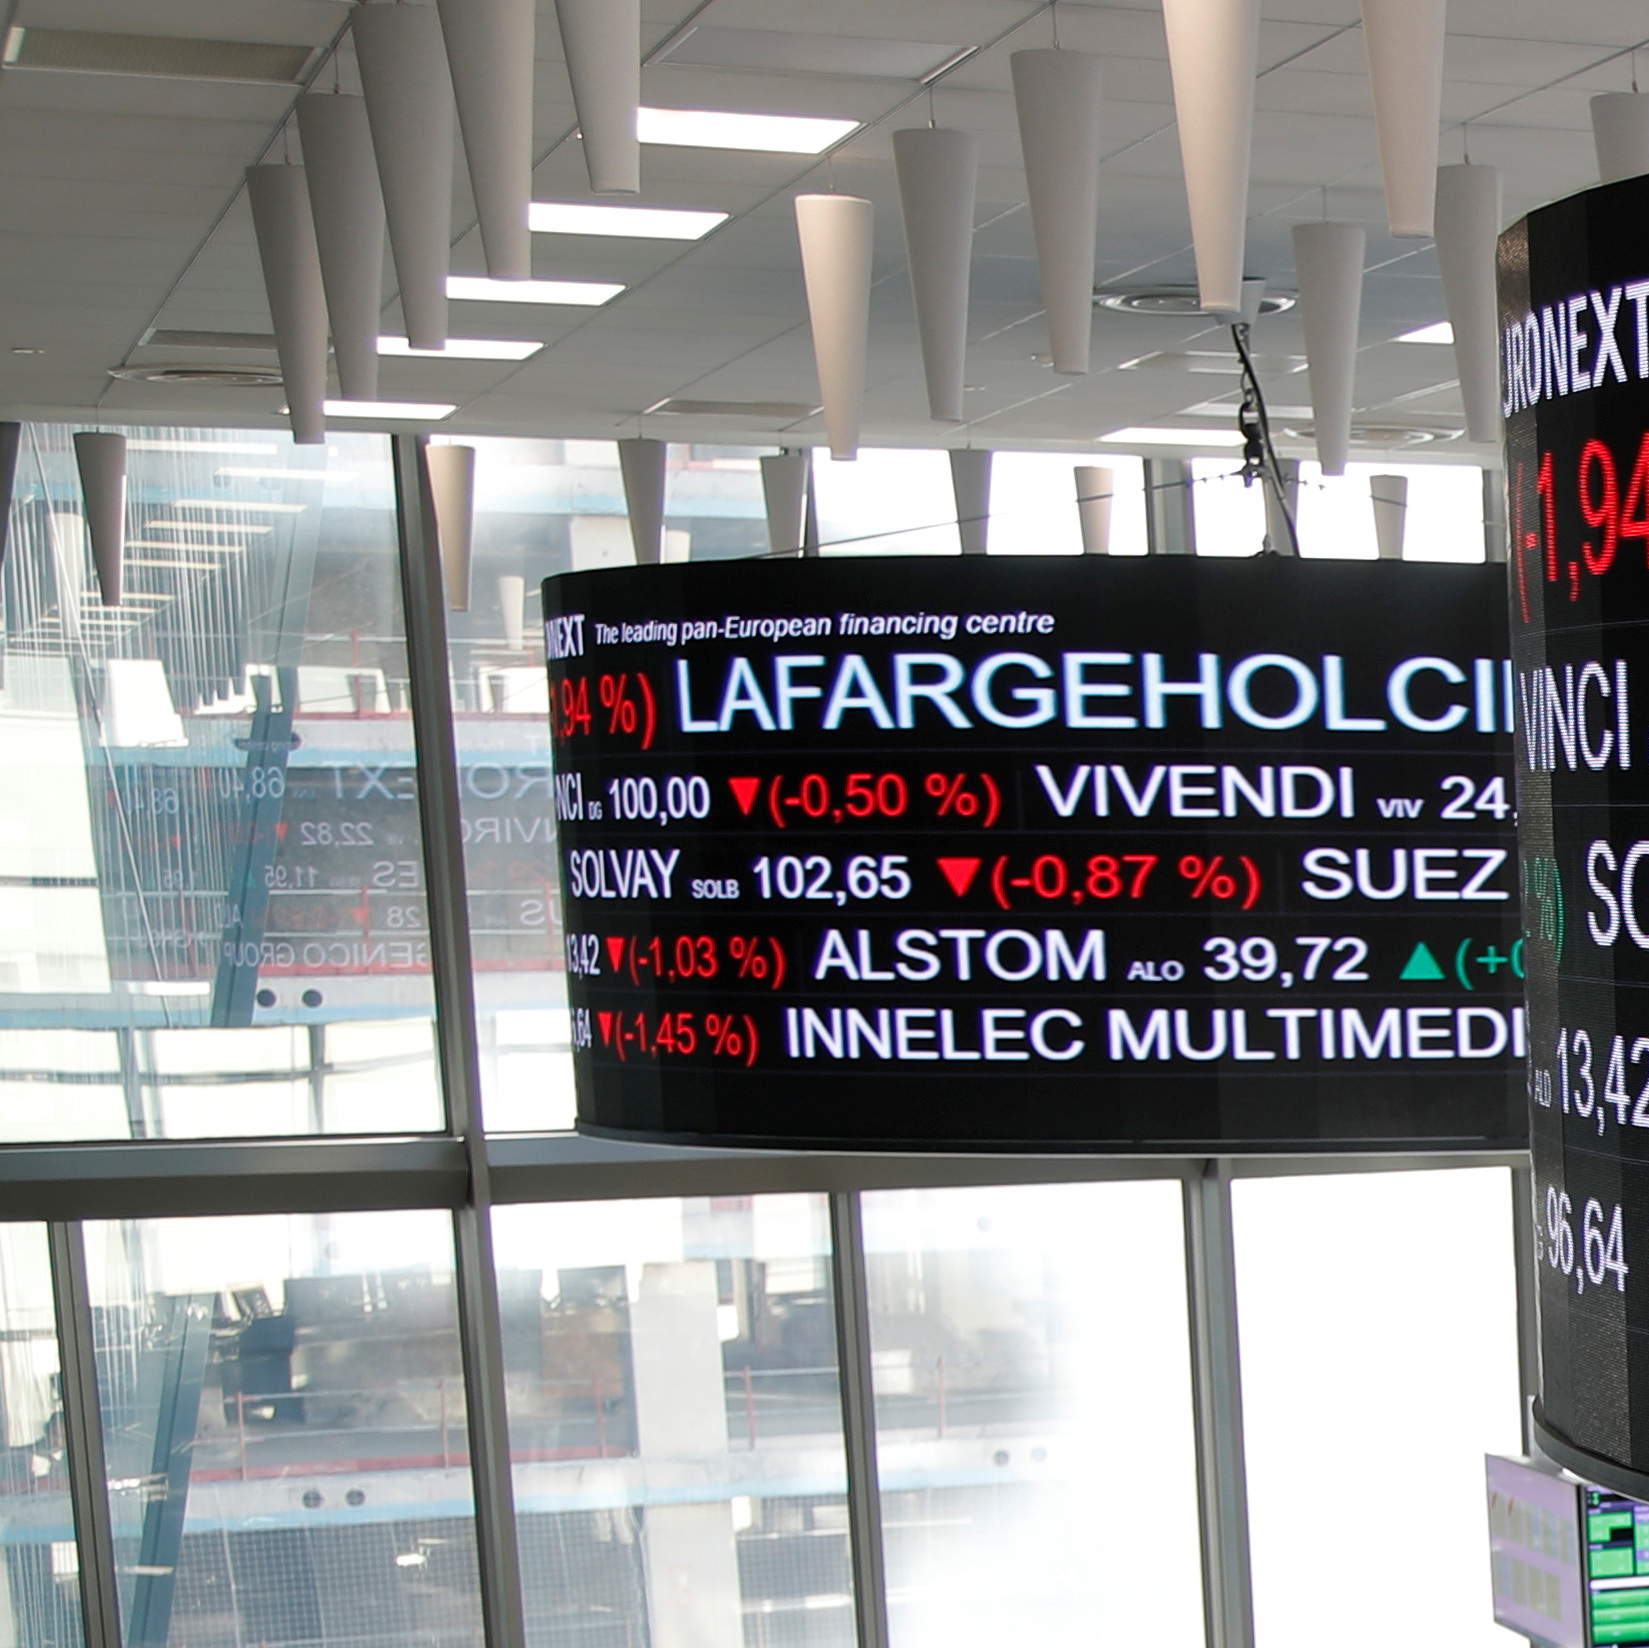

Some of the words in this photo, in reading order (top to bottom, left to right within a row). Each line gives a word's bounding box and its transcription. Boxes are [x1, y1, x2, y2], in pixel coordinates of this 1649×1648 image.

[595, 623, 619, 645] The
[621, 619, 678, 647] leading
[681, 616, 832, 645] pan-European
[838, 612, 958, 640] financing
[964, 611, 1055, 634] centre
[600, 673, 656, 749] %)
[676, 653, 1515, 734] LAFARGEHOLCI
[1519, 660, 1630, 772] VINCI
[608, 776, 710, 825] 100,00
[769, 773, 907, 827] (-0,50
[925, 773, 1000, 827] %)
[1035, 765, 1354, 818] VIVENDI
[1376, 798, 1423, 818] VIV
[570, 849, 680, 898] SOLVAY
[690, 879, 740, 899] SOLB
[753, 855, 911, 906] 102,65
[992, 855, 1158, 909] (-0,87
[1179, 855, 1261, 910] %)
[1301, 848, 1509, 900] SUEZ
[629, 935, 718, 984] (-1,03
[729, 936, 786, 989] %)
[814, 929, 1106, 981] ALSTOM
[1127, 960, 1184, 981] ALO
[1203, 937, 1368, 987] 39,72
[616, 1010, 698, 1062] (-1,45
[705, 1013, 758, 1066] %)
[785, 1008, 1084, 1060] INNELEC
[1107, 1004, 1526, 1060] MULTIMEDI
[1546, 1186, 1629, 1295] 96,64
